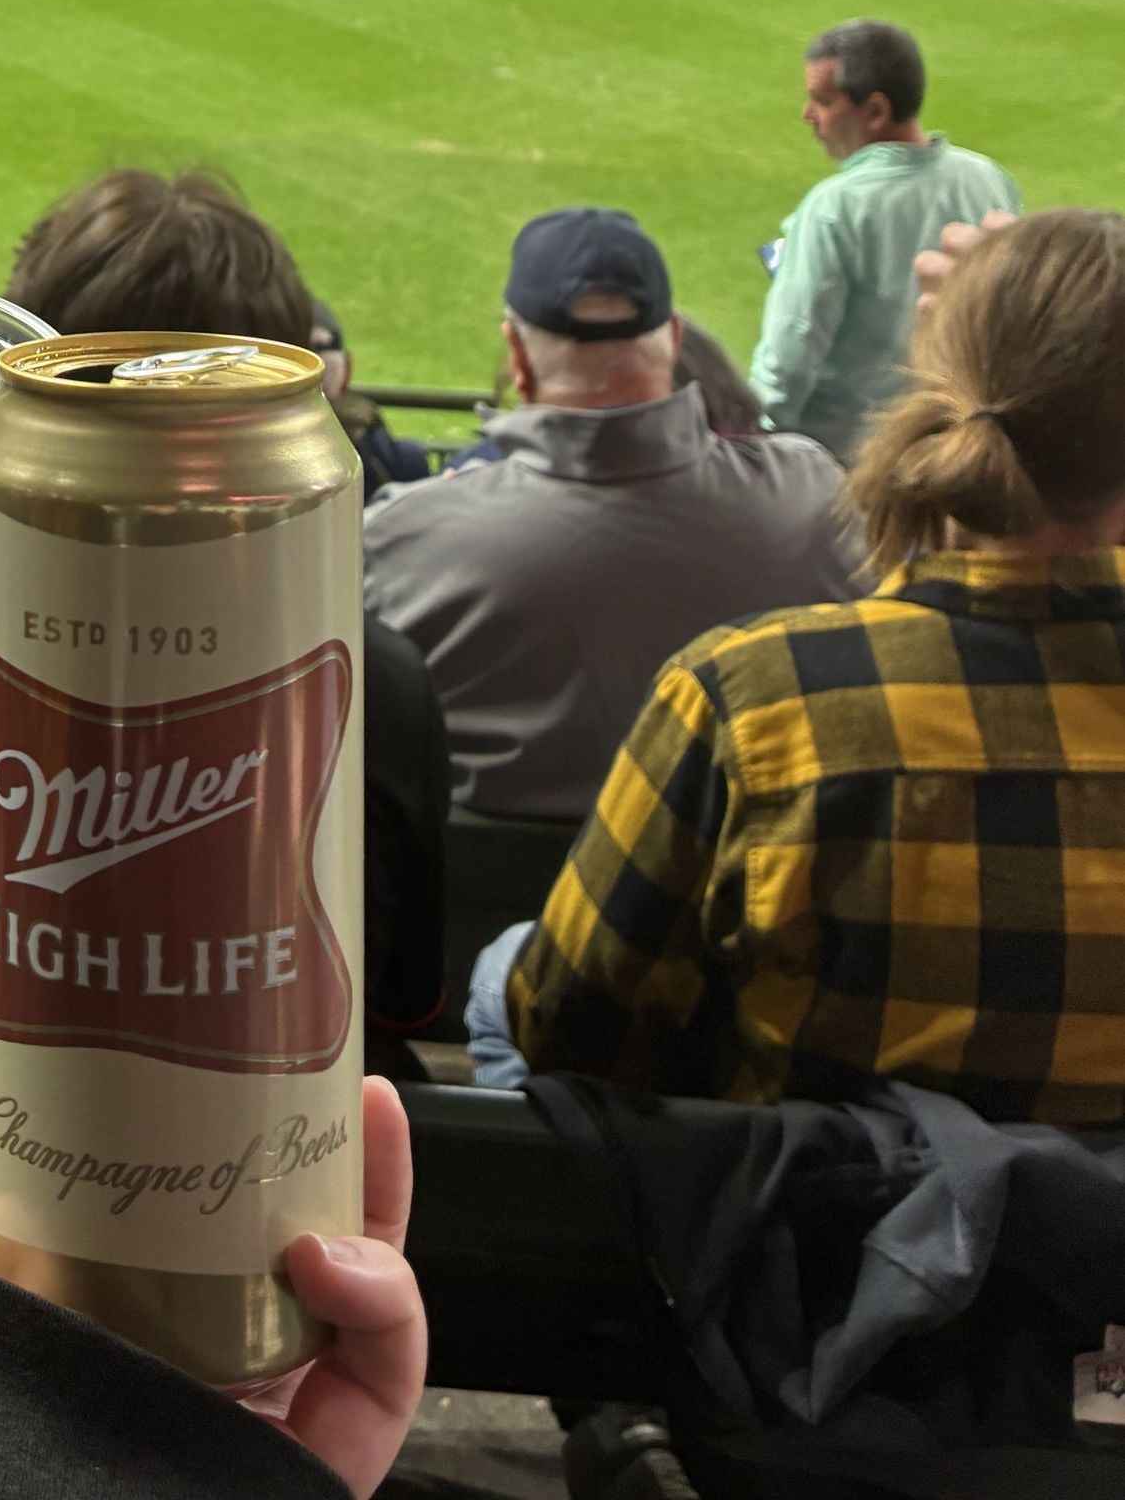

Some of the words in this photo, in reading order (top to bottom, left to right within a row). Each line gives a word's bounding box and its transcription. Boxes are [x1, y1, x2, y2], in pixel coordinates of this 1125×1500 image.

[23, 610, 106, 649] ESTD
[127, 625, 218, 656] 1903
[142, 926, 299, 997] LIFE
[199, 1133, 263, 1216] of
[246, 1112, 348, 1184] Beers
